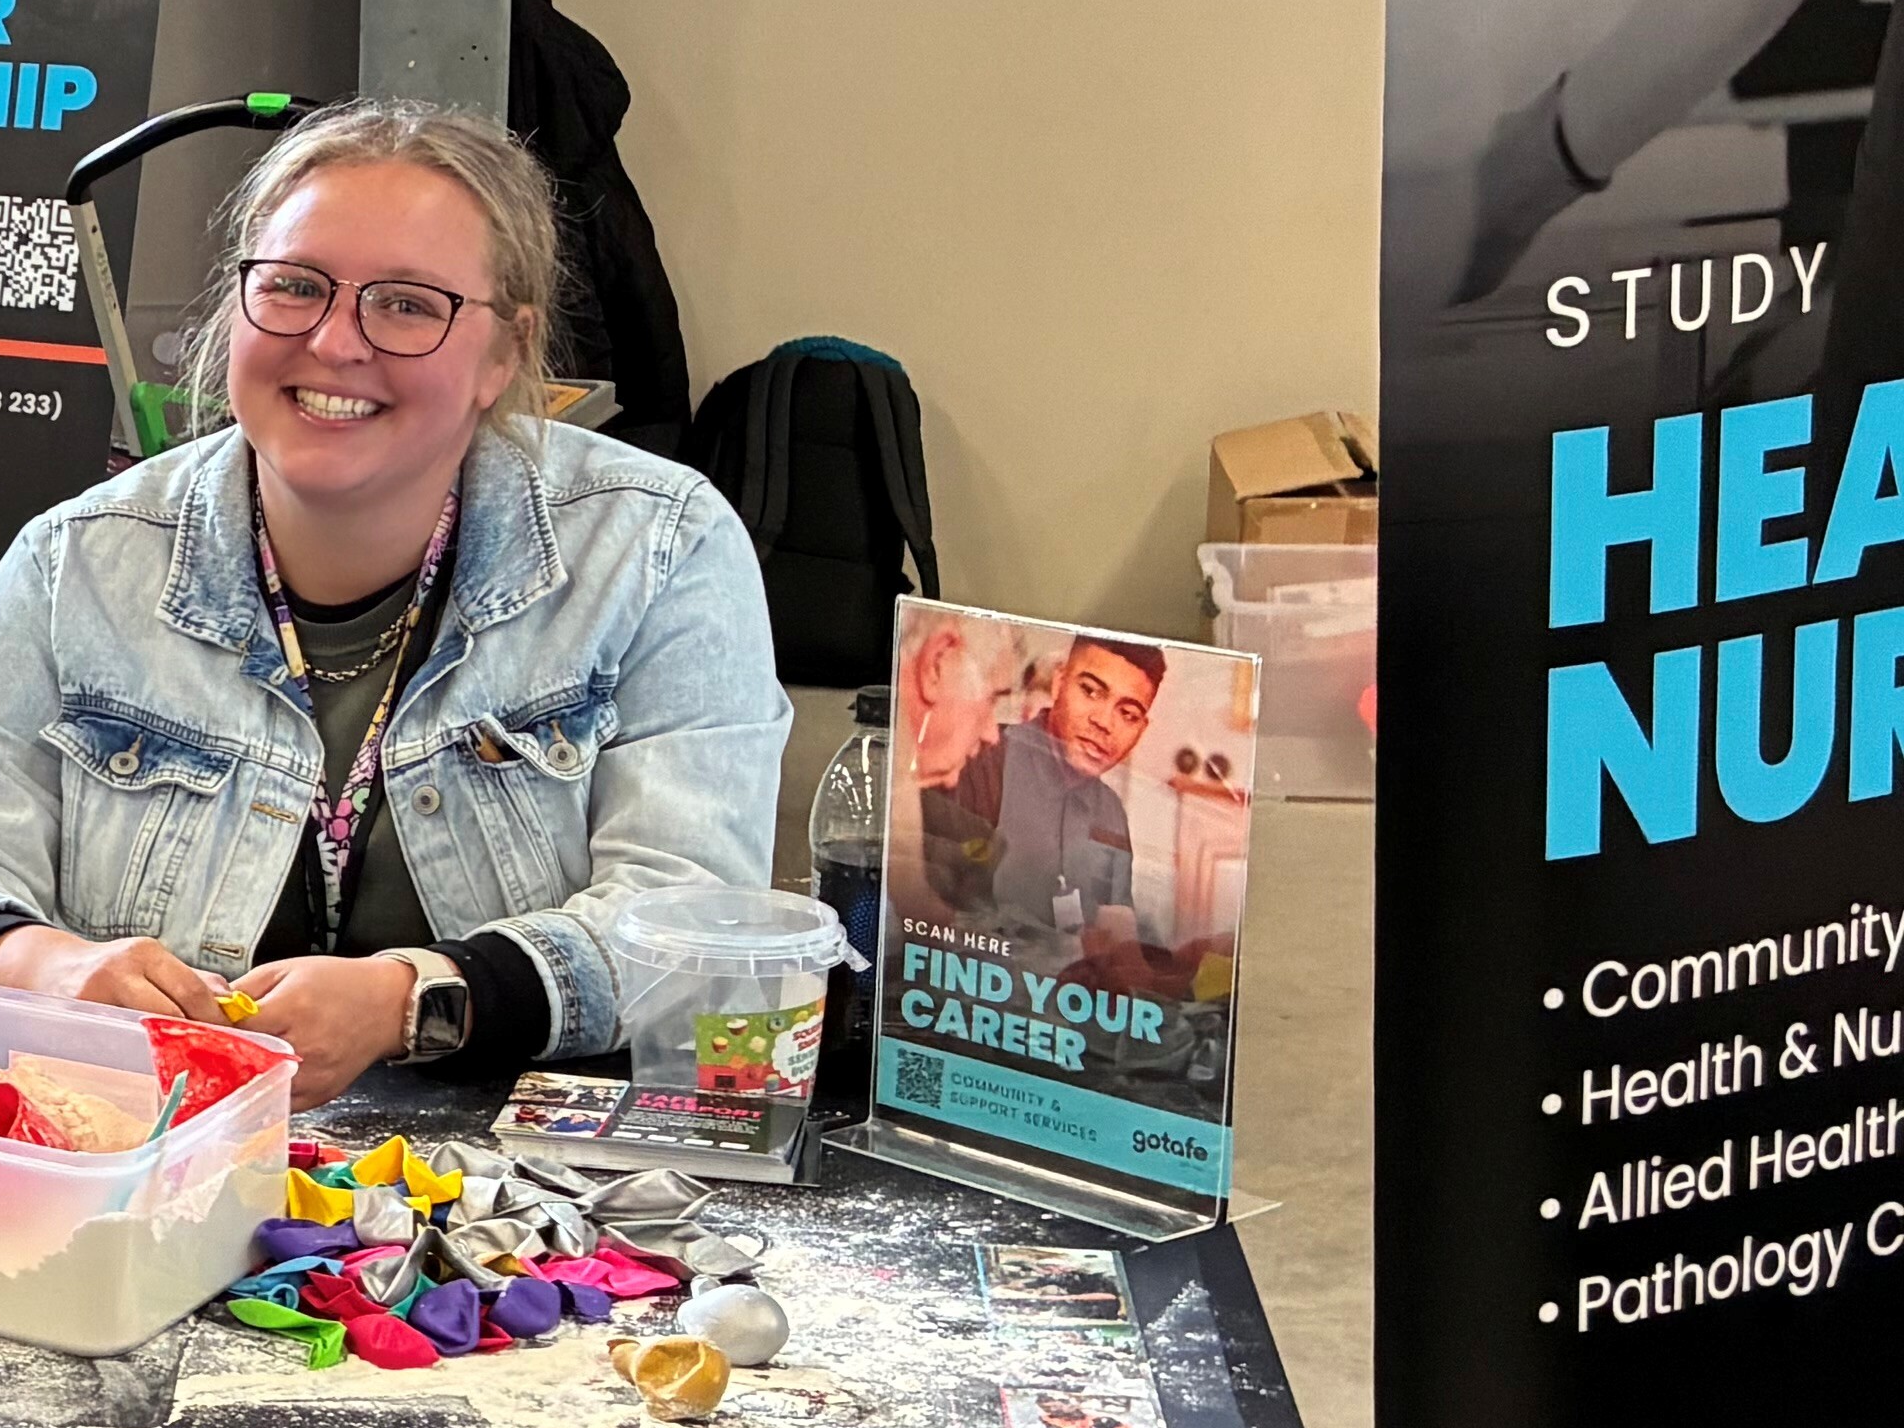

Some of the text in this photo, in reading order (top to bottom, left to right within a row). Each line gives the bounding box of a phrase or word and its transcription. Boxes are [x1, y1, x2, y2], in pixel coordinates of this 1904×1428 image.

[1546, 243, 1826, 347] STUDY
[8, 391, 62, 421] 233)
[904, 918, 1012, 957] SCAN HERE
[1583, 903, 1904, 1017] Community
[901, 990, 1086, 1072] CAREER
[904, 943, 1164, 1045] FIND YOUR
[950, 1070, 1046, 1108] COMMUNITY
[950, 1090, 1098, 1143] SUPPORT SERVICES
[1582, 1035, 1762, 1124] Health
[1779, 1023, 1818, 1079] &
[1132, 1128, 1209, 1164] gotafe
[1579, 1099, 1904, 1229] Allied Health
[1579, 1223, 1853, 1332] Pathology
